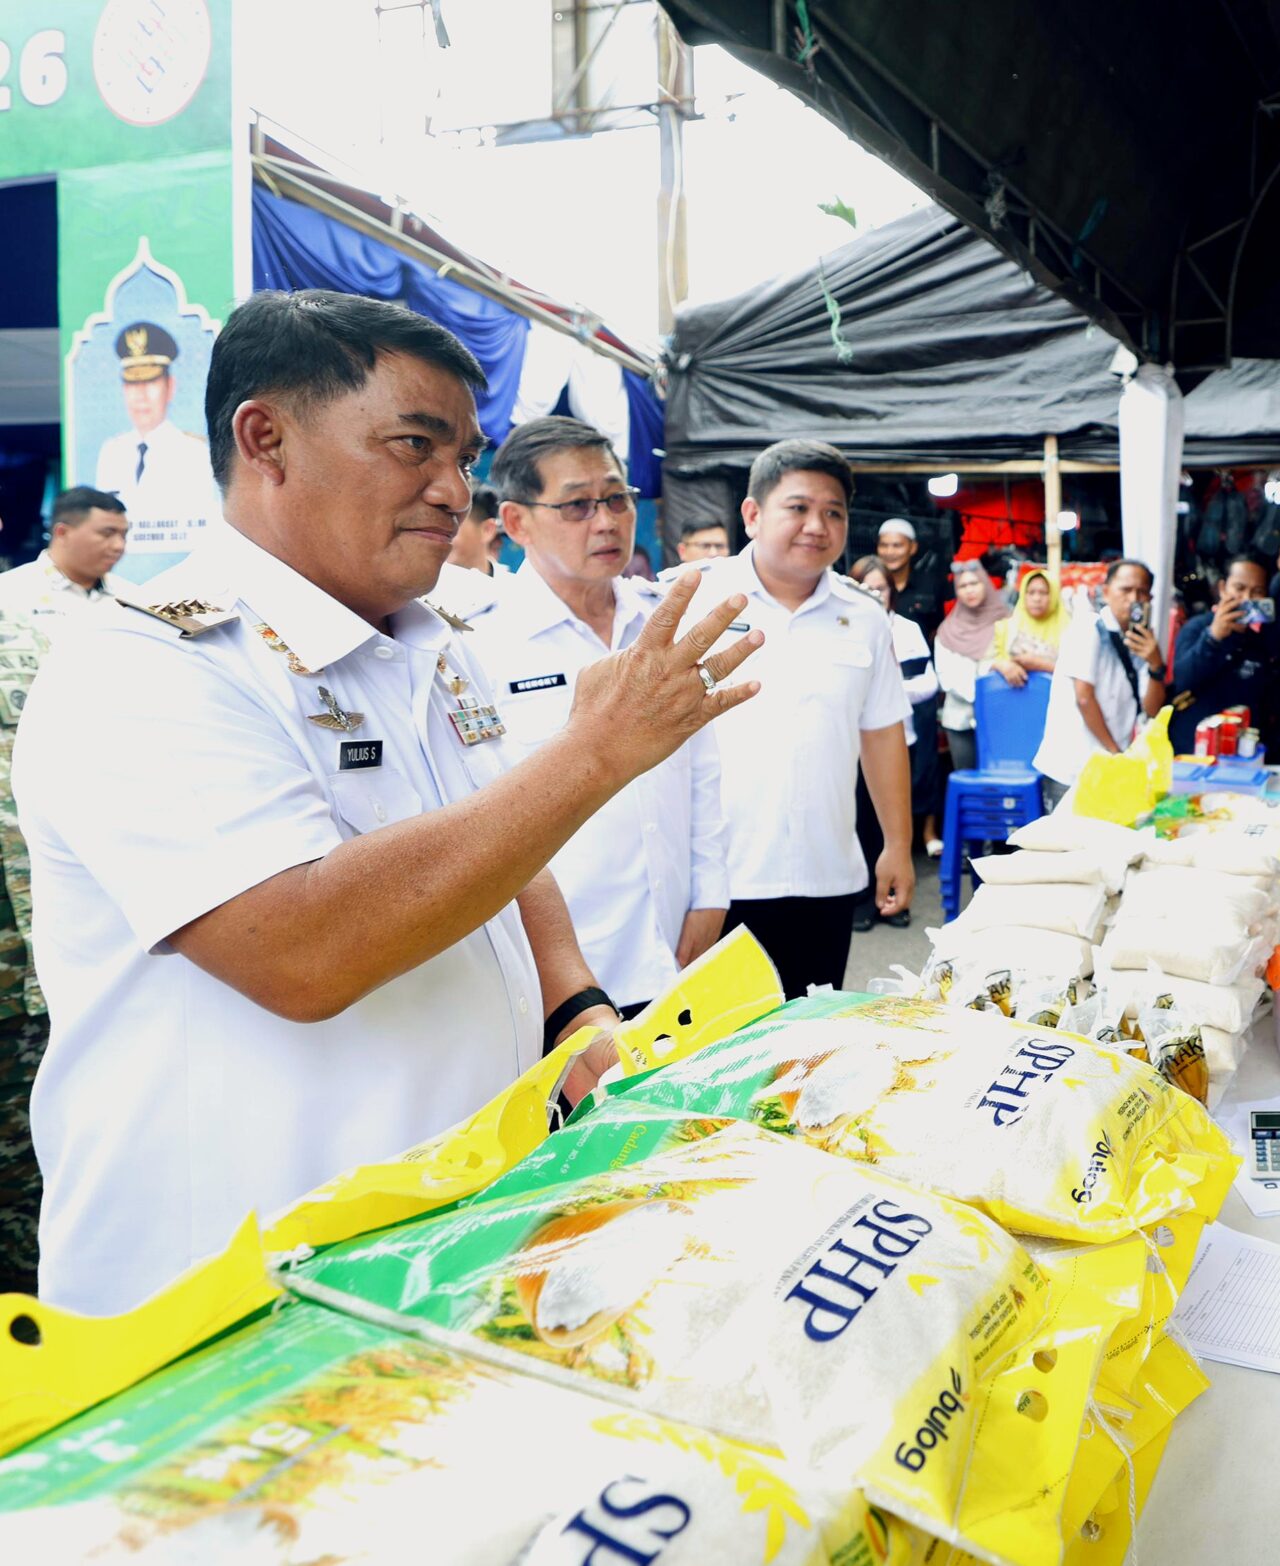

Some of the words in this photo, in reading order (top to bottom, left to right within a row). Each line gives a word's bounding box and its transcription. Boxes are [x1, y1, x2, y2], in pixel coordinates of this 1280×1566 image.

[0, 28, 67, 111] 6
[347, 747, 369, 762] YULIUS
[370, 746, 376, 760] S
[977, 1038, 1075, 1128] SPHP
[609, 1125, 647, 1169] Cadang
[1071, 1140, 1114, 1203] bulog
[784, 1199, 932, 1343] SPHP
[895, 1390, 964, 1474] bulog
